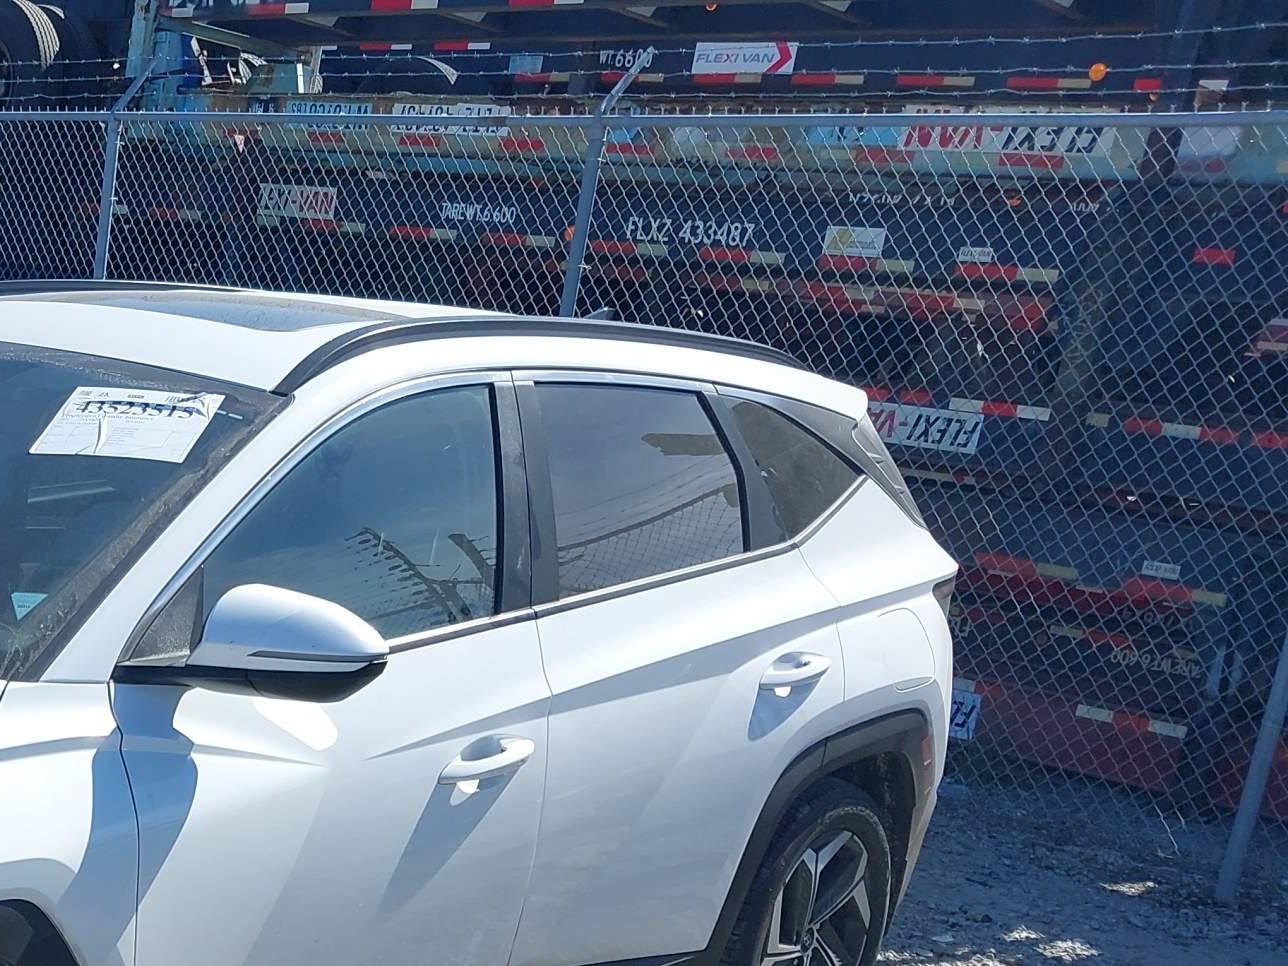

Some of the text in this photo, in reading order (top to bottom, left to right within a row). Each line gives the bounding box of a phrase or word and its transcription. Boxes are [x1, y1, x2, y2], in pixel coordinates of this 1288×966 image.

[742, 53, 776, 64] VAN
[625, 216, 756, 247] FLXZ 433487
[867, 407, 980, 449] FLEXI-VA
